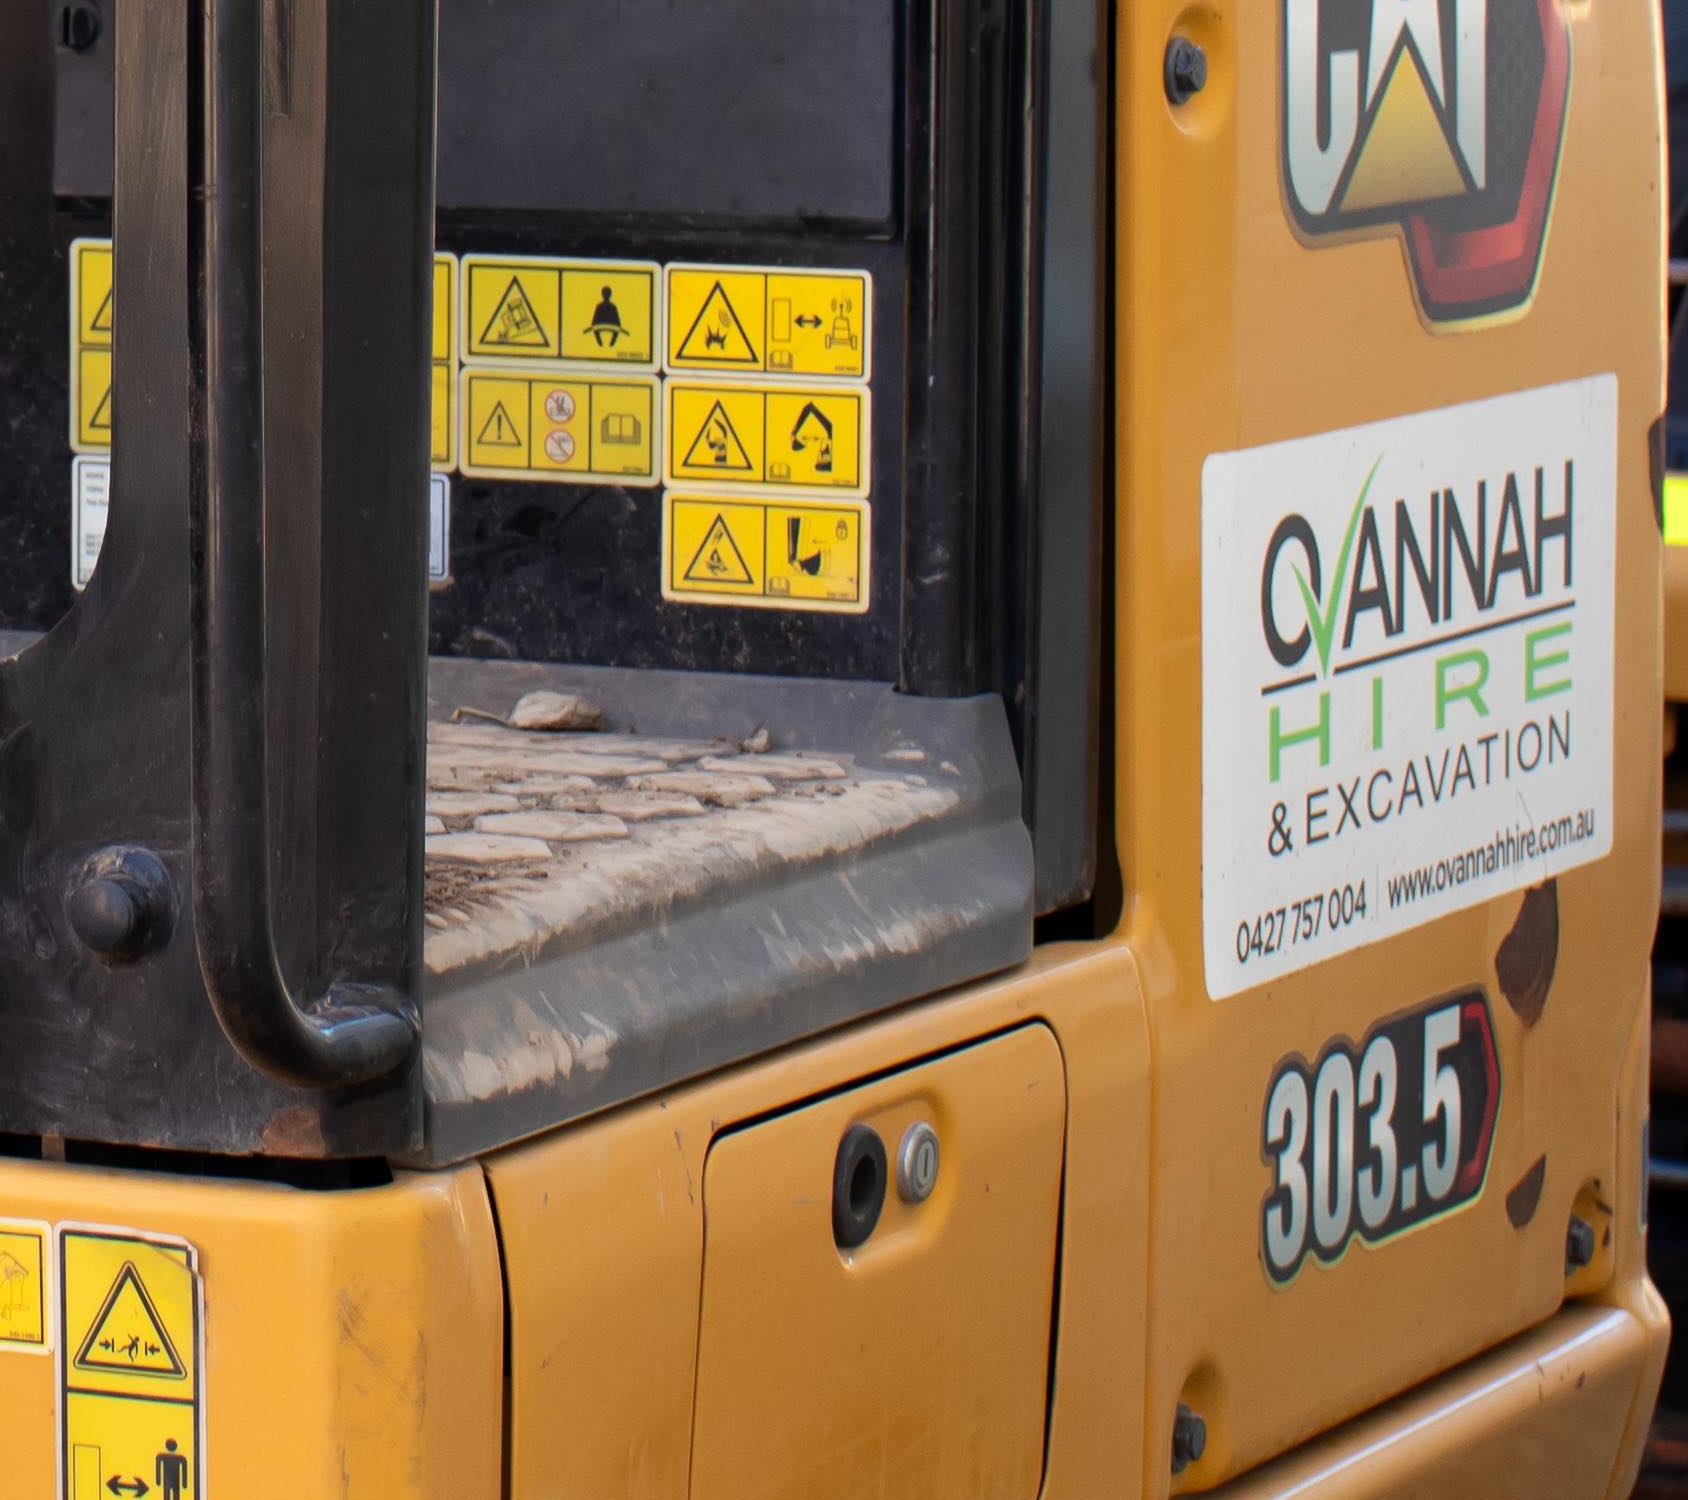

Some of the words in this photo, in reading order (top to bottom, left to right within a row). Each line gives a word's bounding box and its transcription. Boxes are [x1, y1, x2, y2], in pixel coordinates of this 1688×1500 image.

[1268, 620, 1572, 783] HIRE
[1267, 801, 1293, 858] &
[1305, 709, 1572, 845] EXCAVATION
[1236, 911, 1286, 965] 0427
[1291, 895, 1324, 949] 757
[1327, 878, 1367, 931] 004
[1387, 807, 1595, 910] www.ovannahhire.com.au
[1266, 1003, 1462, 1268] 303.5
